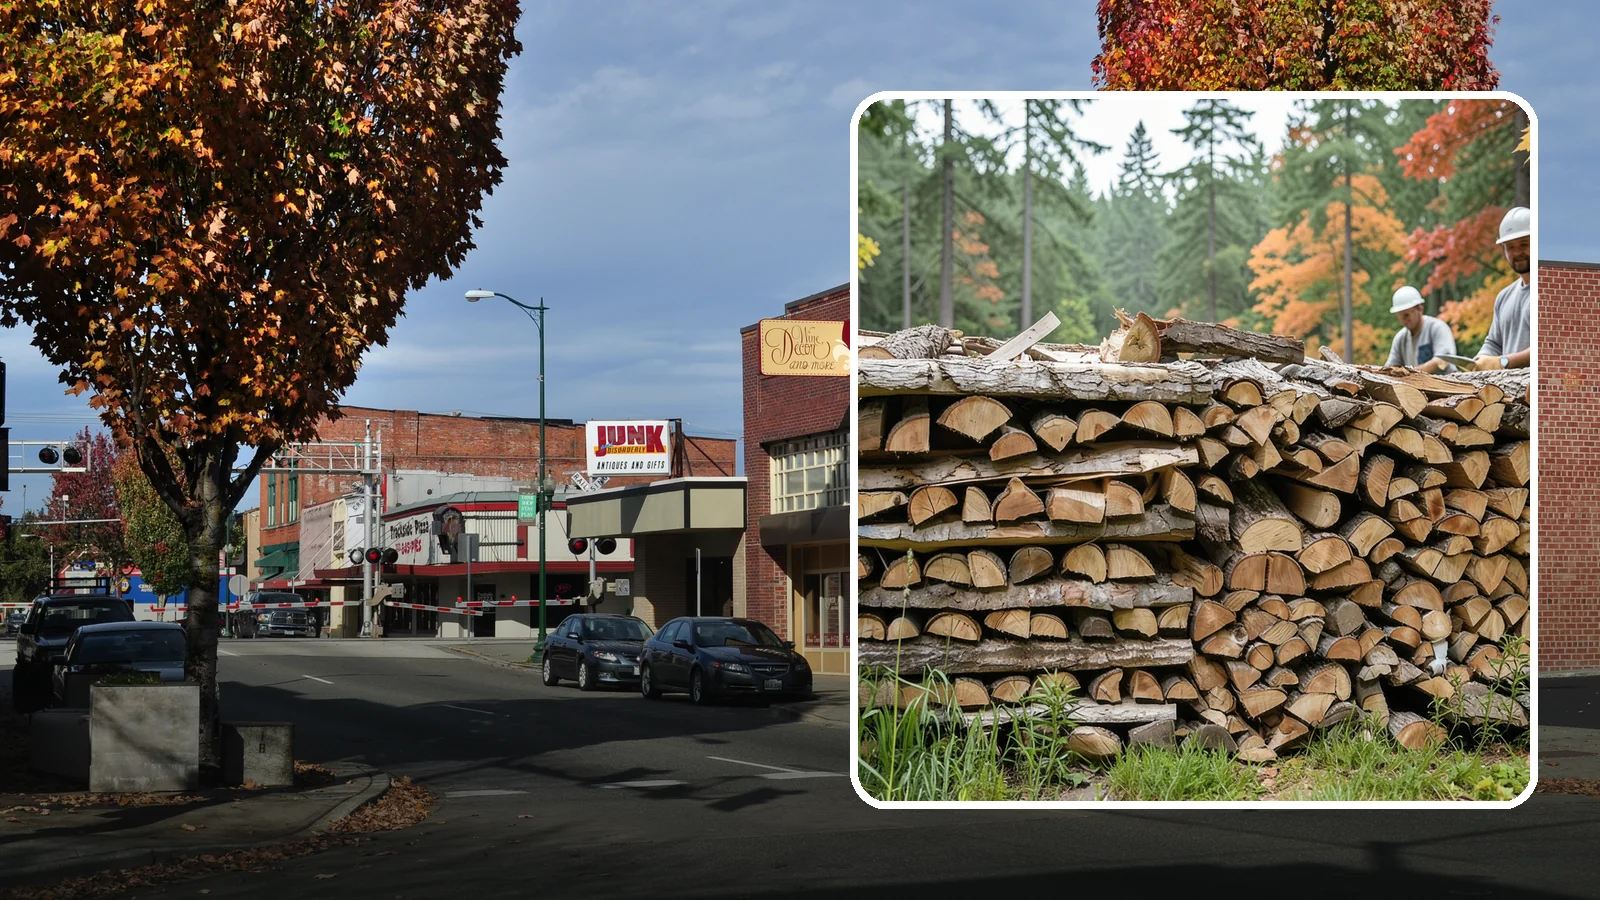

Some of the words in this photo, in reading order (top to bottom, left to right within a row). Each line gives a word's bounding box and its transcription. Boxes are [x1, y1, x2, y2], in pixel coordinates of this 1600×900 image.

[595, 425, 665, 457] JUNK
[597, 461, 628, 470] ANTIQUES
[631, 461, 644, 470] AND
[646, 460, 666, 470] GIFTS
[414, 519, 429, 535] Pizza
